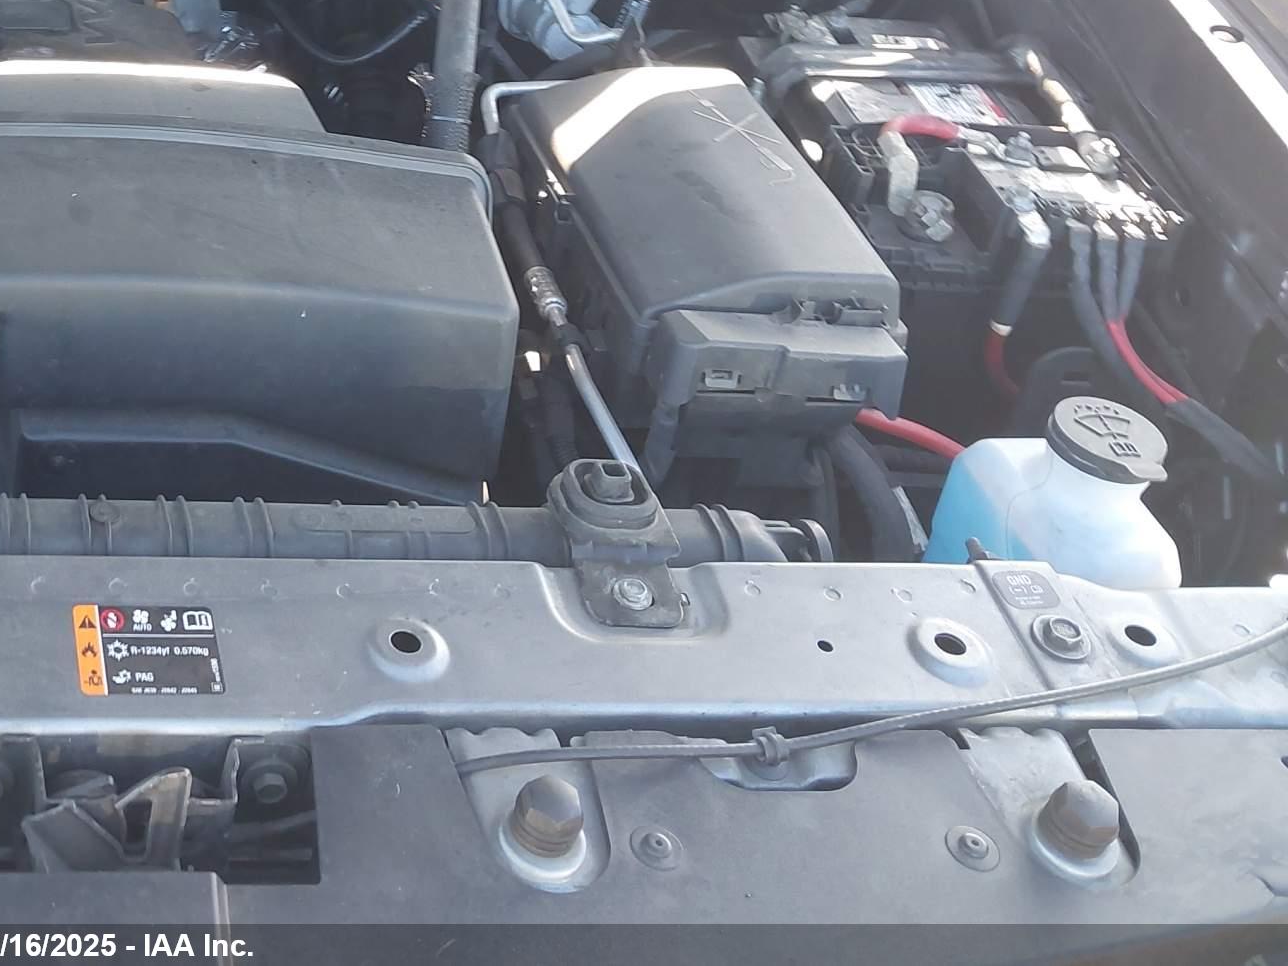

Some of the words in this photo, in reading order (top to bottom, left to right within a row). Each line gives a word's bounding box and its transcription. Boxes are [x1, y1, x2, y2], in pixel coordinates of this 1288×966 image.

[133, 623, 152, 632] AUTO
[130, 646, 170, 657] R-1234yf
[135, 672, 154, 683] PAG
